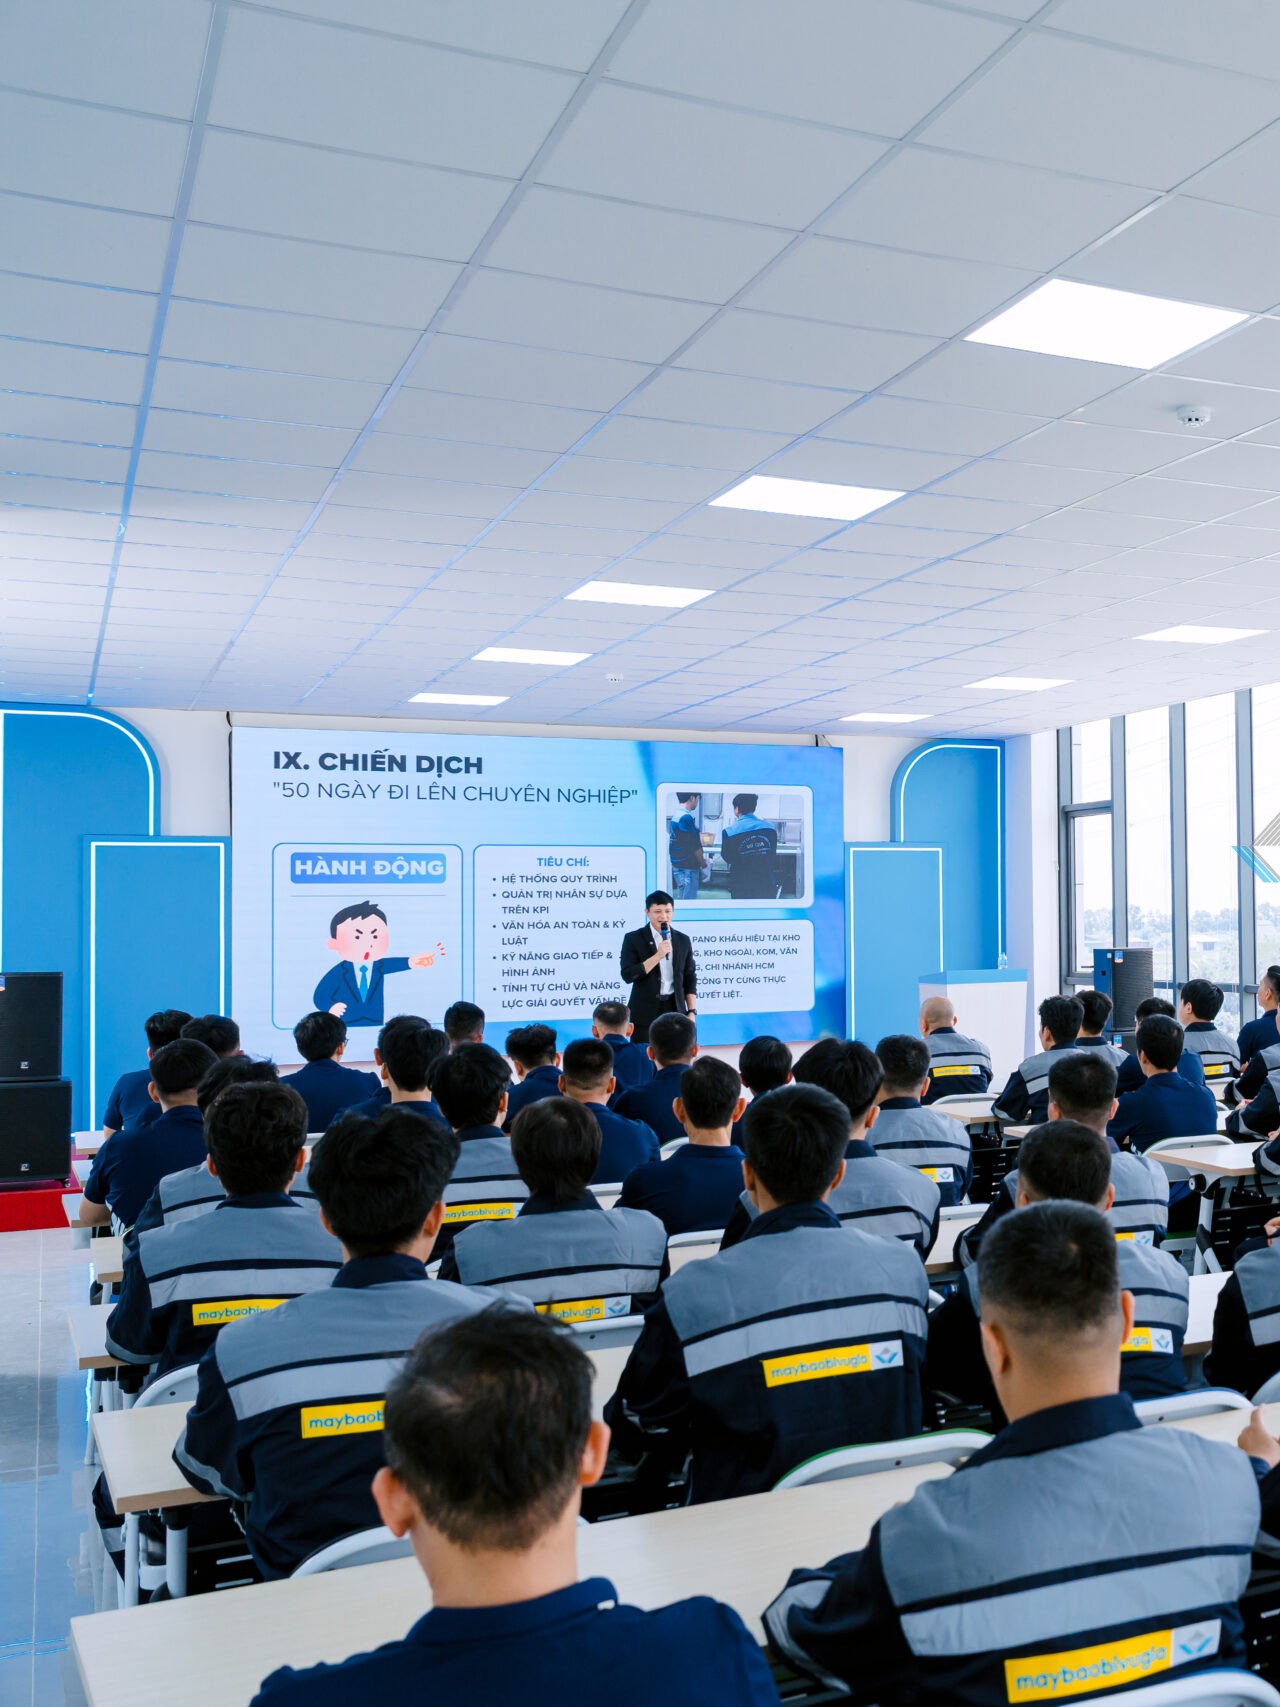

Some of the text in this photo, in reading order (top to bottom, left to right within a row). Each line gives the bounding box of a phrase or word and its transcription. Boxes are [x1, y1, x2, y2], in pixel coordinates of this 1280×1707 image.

[274, 749, 483, 778] IX. CHIẾN DỊCH
[273, 780, 638, 806] "50 NGÀY ĐI LÊN CHUYÊN NGHIỆP"
[537, 856, 590, 867] TIÊU CHÍ:
[295, 856, 444, 880] HÀNH ĐỘNG
[502, 873, 617, 884] HỆ THỐNG QUY TRÌNH
[537, 890, 552, 900] TRỊ
[555, 888, 586, 898] NHÂN
[589, 889, 603, 899] SỰ
[606, 889, 628, 899] DỰA
[502, 905, 549, 914] TRÊN KPI
[502, 920, 524, 930] VĂN
[528, 919, 551, 929] HÓA
[554, 921, 568, 929] AN
[572, 918, 600, 929] TOÀN
[603, 920, 610, 928] &
[502, 935, 528, 947] LUẬT
[745, 933, 765, 943] HIỆU
[519, 951, 550, 960] NĂNG
[553, 952, 579, 960] GIAO
[582, 949, 603, 960] TIẾP
[606, 951, 613, 959] &
[704, 949, 722, 957] KHO
[502, 967, 529, 977] HÌNH
[722, 962, 753, 970] NHÁNH
[763, 975, 786, 985] THỰC
[502, 982, 528, 992] TÍNH
[531, 982, 545, 993] TỰ
[574, 981, 588, 990] VÀ
[591, 980, 621, 990] NĂNG
[502, 999, 523, 1009] LỰC
[550, 996, 586, 1007] QUYẾT
[771, 1353, 868, 1379] maybaobivugia
[309, 1410, 385, 1430] maybaob
[1016, 1646, 1167, 1691] maybaobivugia
